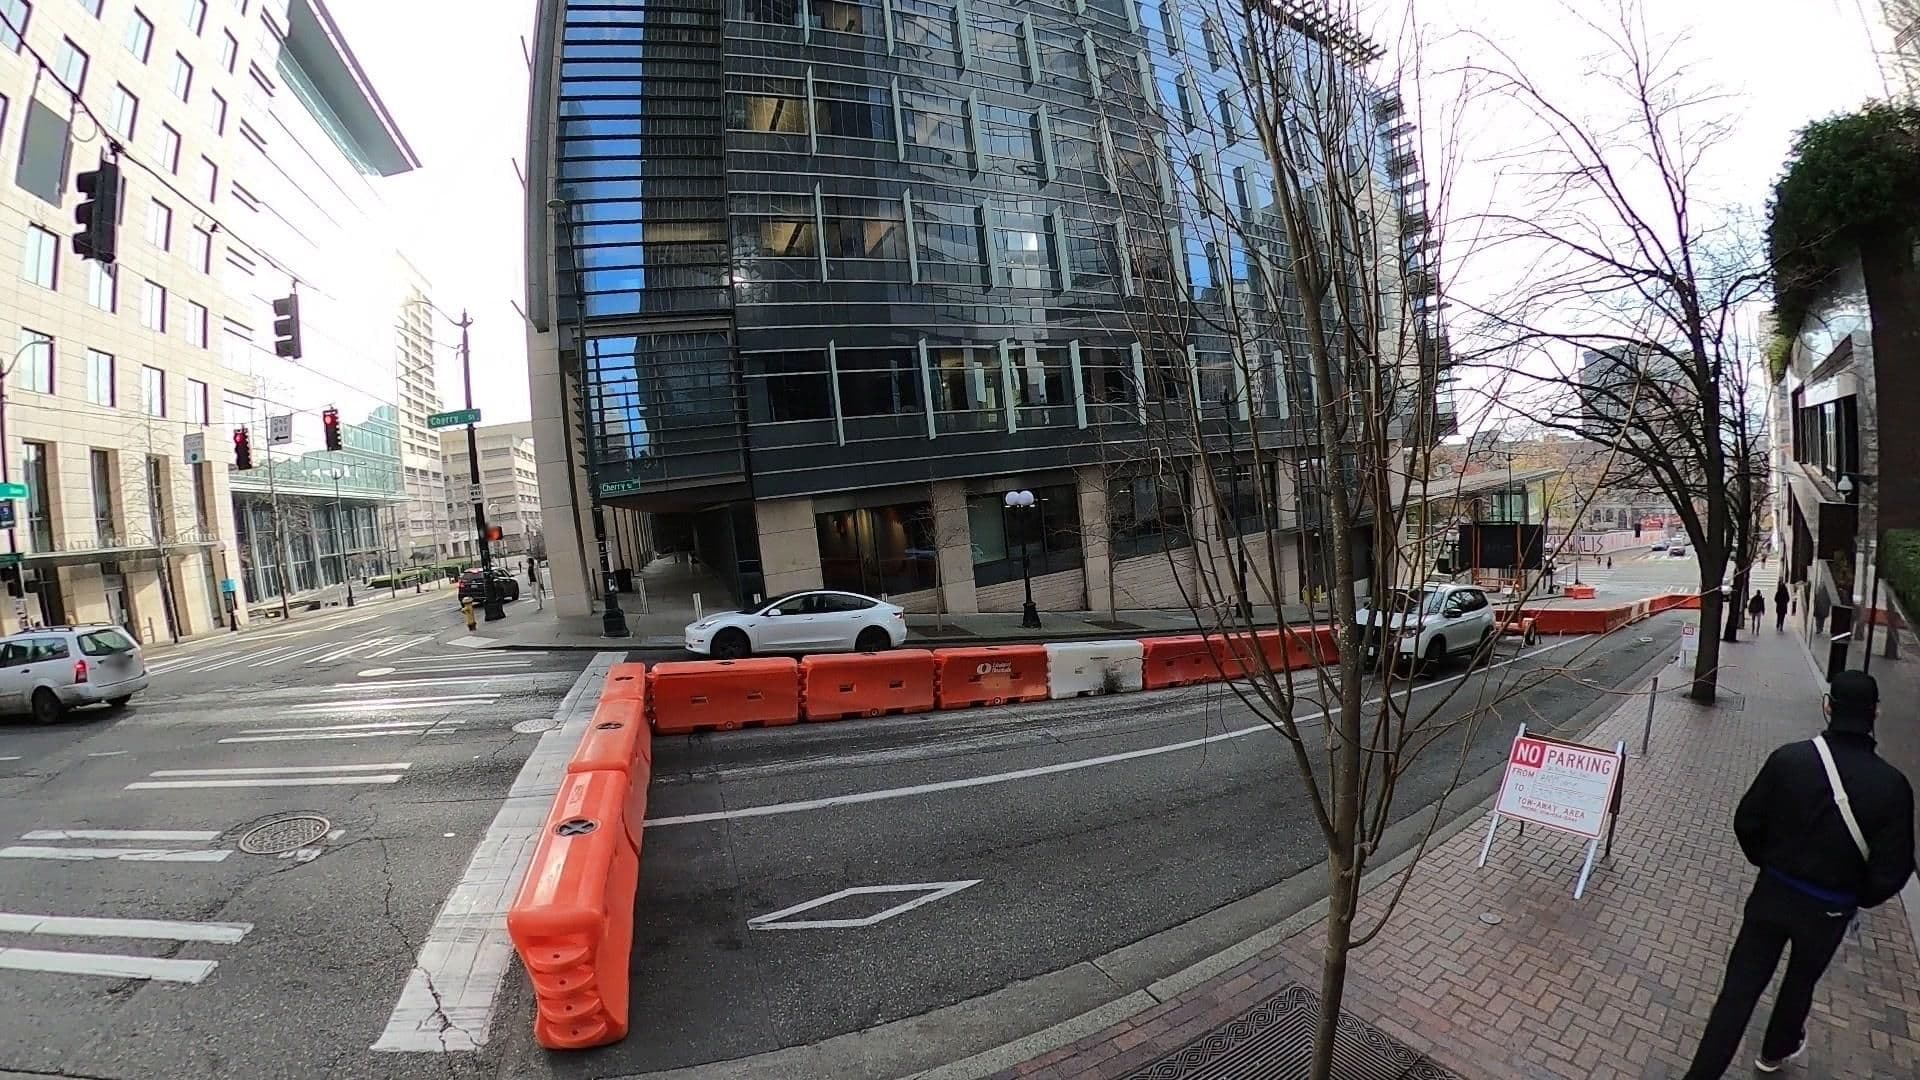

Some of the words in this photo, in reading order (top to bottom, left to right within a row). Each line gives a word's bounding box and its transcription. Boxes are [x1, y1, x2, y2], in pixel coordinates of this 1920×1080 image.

[431, 415, 459, 425] Cherry
[603, 482, 626, 491] Cherry
[1516, 742, 1542, 764] NO
[1547, 750, 1612, 775] PARKING
[1512, 767, 1535, 777] FROM
[1514, 784, 1525, 792] TO
[1518, 796, 1557, 813] TOW-AWAY
[1563, 807, 1585, 819] AREA
